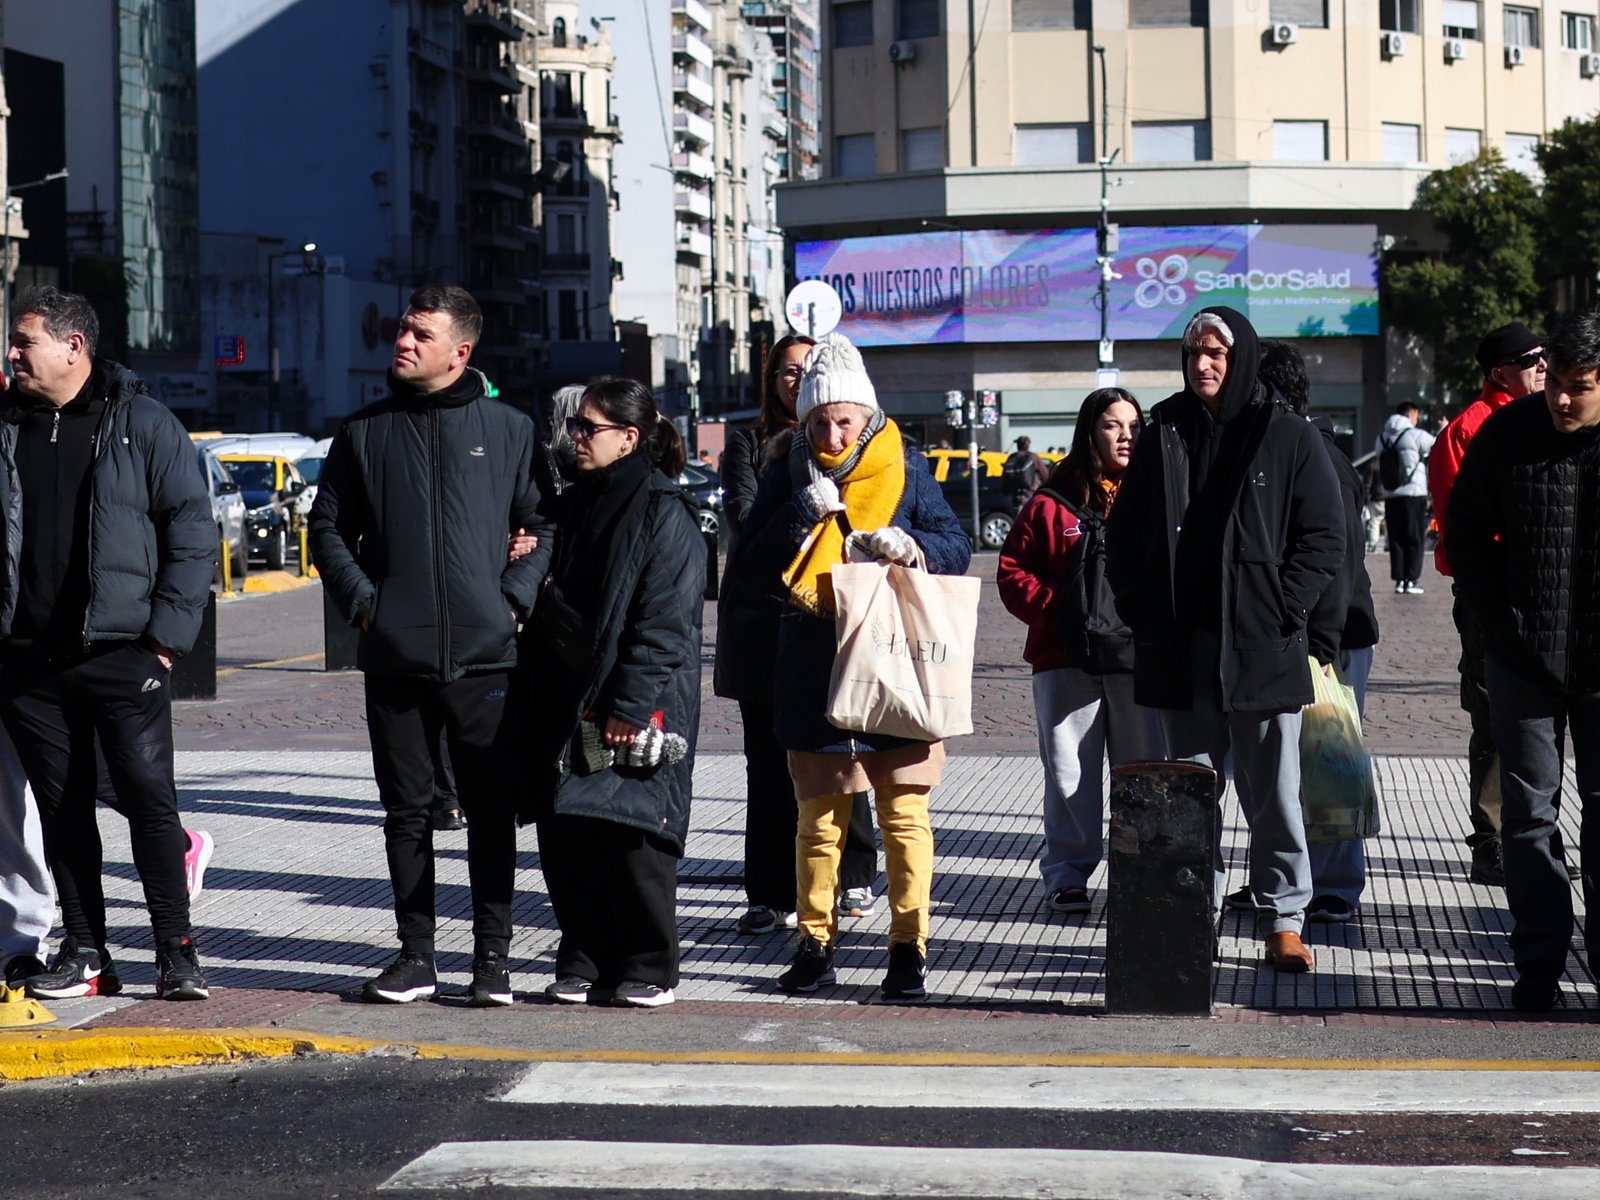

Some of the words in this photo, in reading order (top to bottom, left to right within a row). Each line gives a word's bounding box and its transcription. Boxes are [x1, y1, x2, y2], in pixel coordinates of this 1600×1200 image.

[804, 273, 855, 313] OS
[863, 267, 943, 312] NUESTROS
[950, 264, 1049, 308] COLORES
[1194, 268, 1350, 291] SanCorSalud
